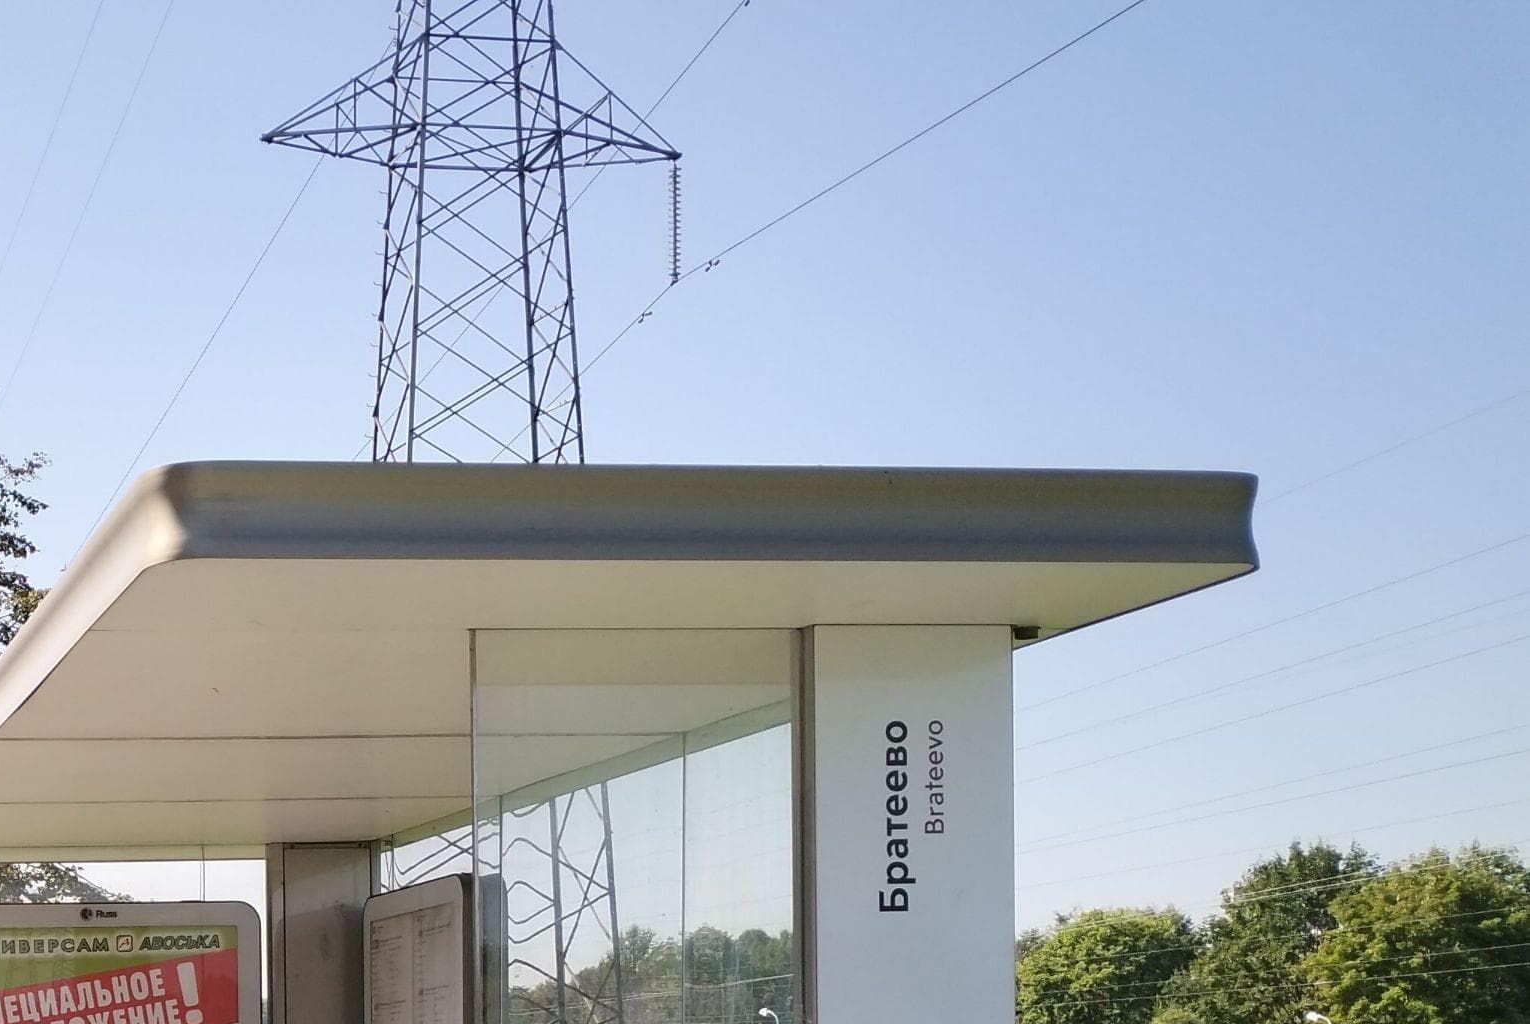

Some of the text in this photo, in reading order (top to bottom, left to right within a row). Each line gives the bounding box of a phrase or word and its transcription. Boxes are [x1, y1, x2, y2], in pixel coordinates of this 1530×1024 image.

[925, 720, 945, 834] Brateevo
[879, 721, 917, 912] Братеево
[95, 909, 118, 918] Russ
[139, 934, 221, 951] АВОСЬКА
